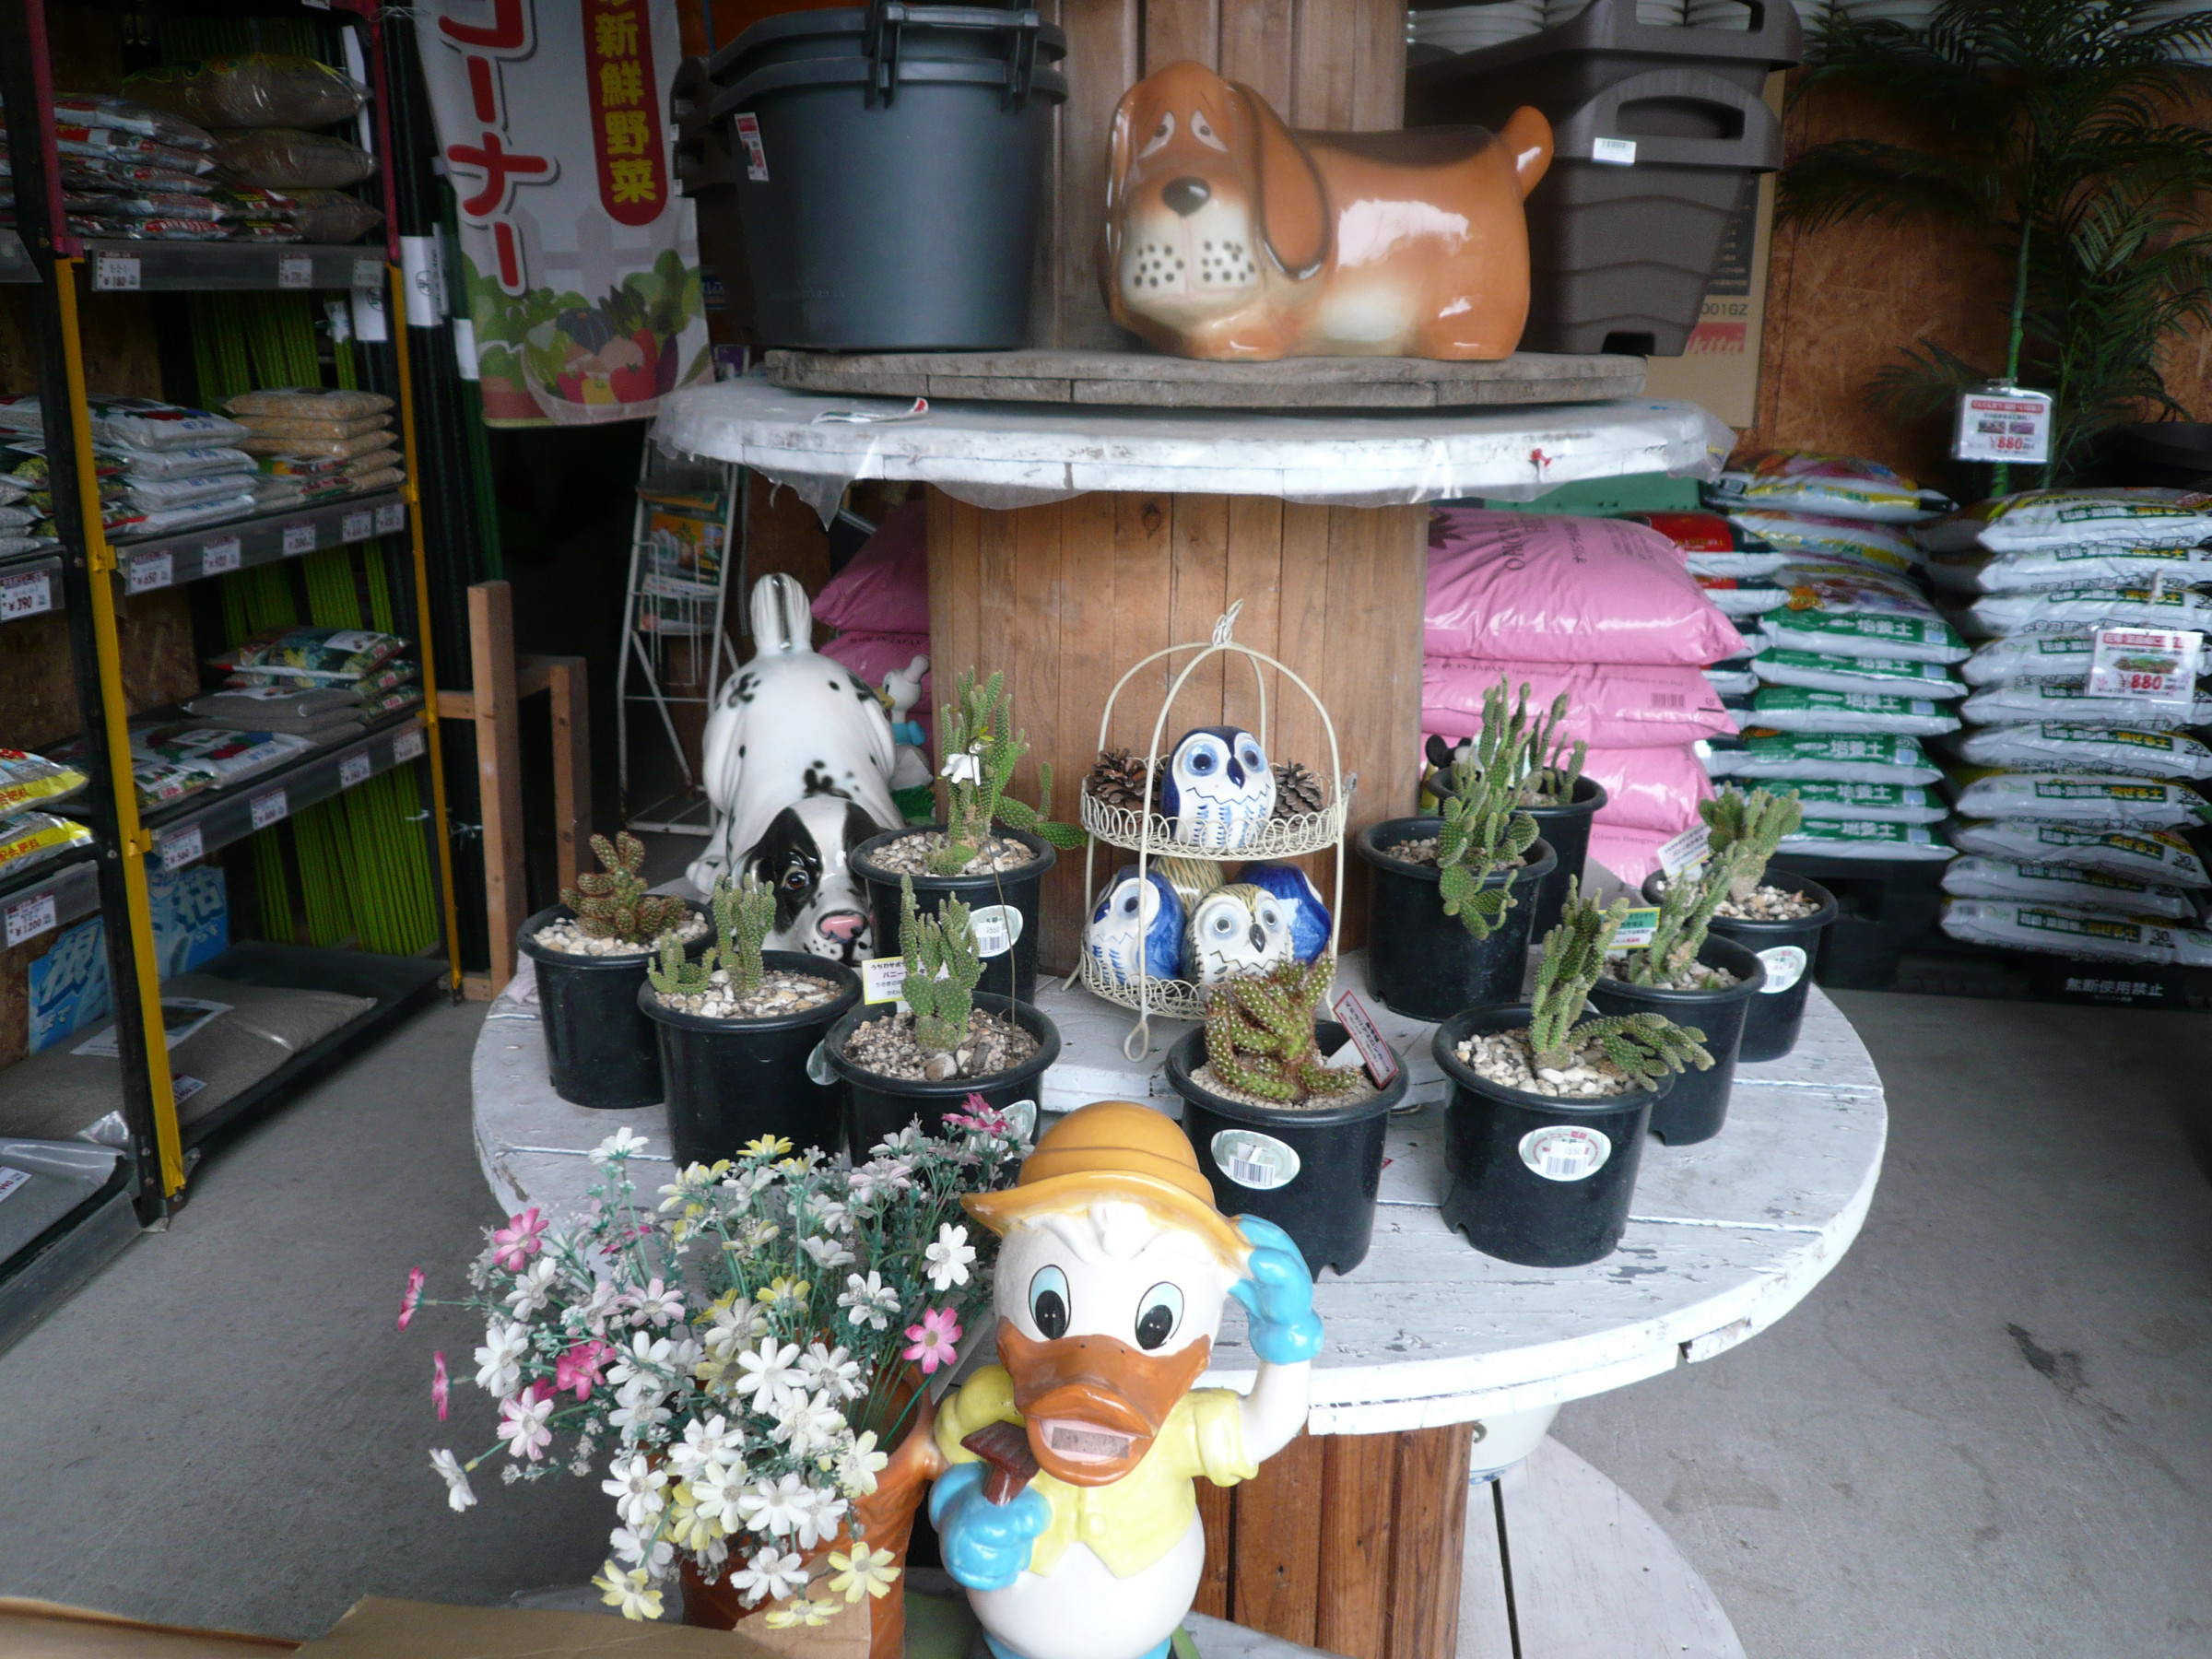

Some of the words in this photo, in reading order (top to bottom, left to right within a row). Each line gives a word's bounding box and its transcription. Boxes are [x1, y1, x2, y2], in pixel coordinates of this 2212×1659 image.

[594, 0, 657, 204] 新鮮野菜
[1856, 618, 1913, 637] 培養土
[2119, 674, 2163, 690] ¥880
[1830, 740, 1884, 758] 培養土
[1837, 784, 1892, 800] 培養土
[2065, 977, 2165, 996] 無断使用禁止
